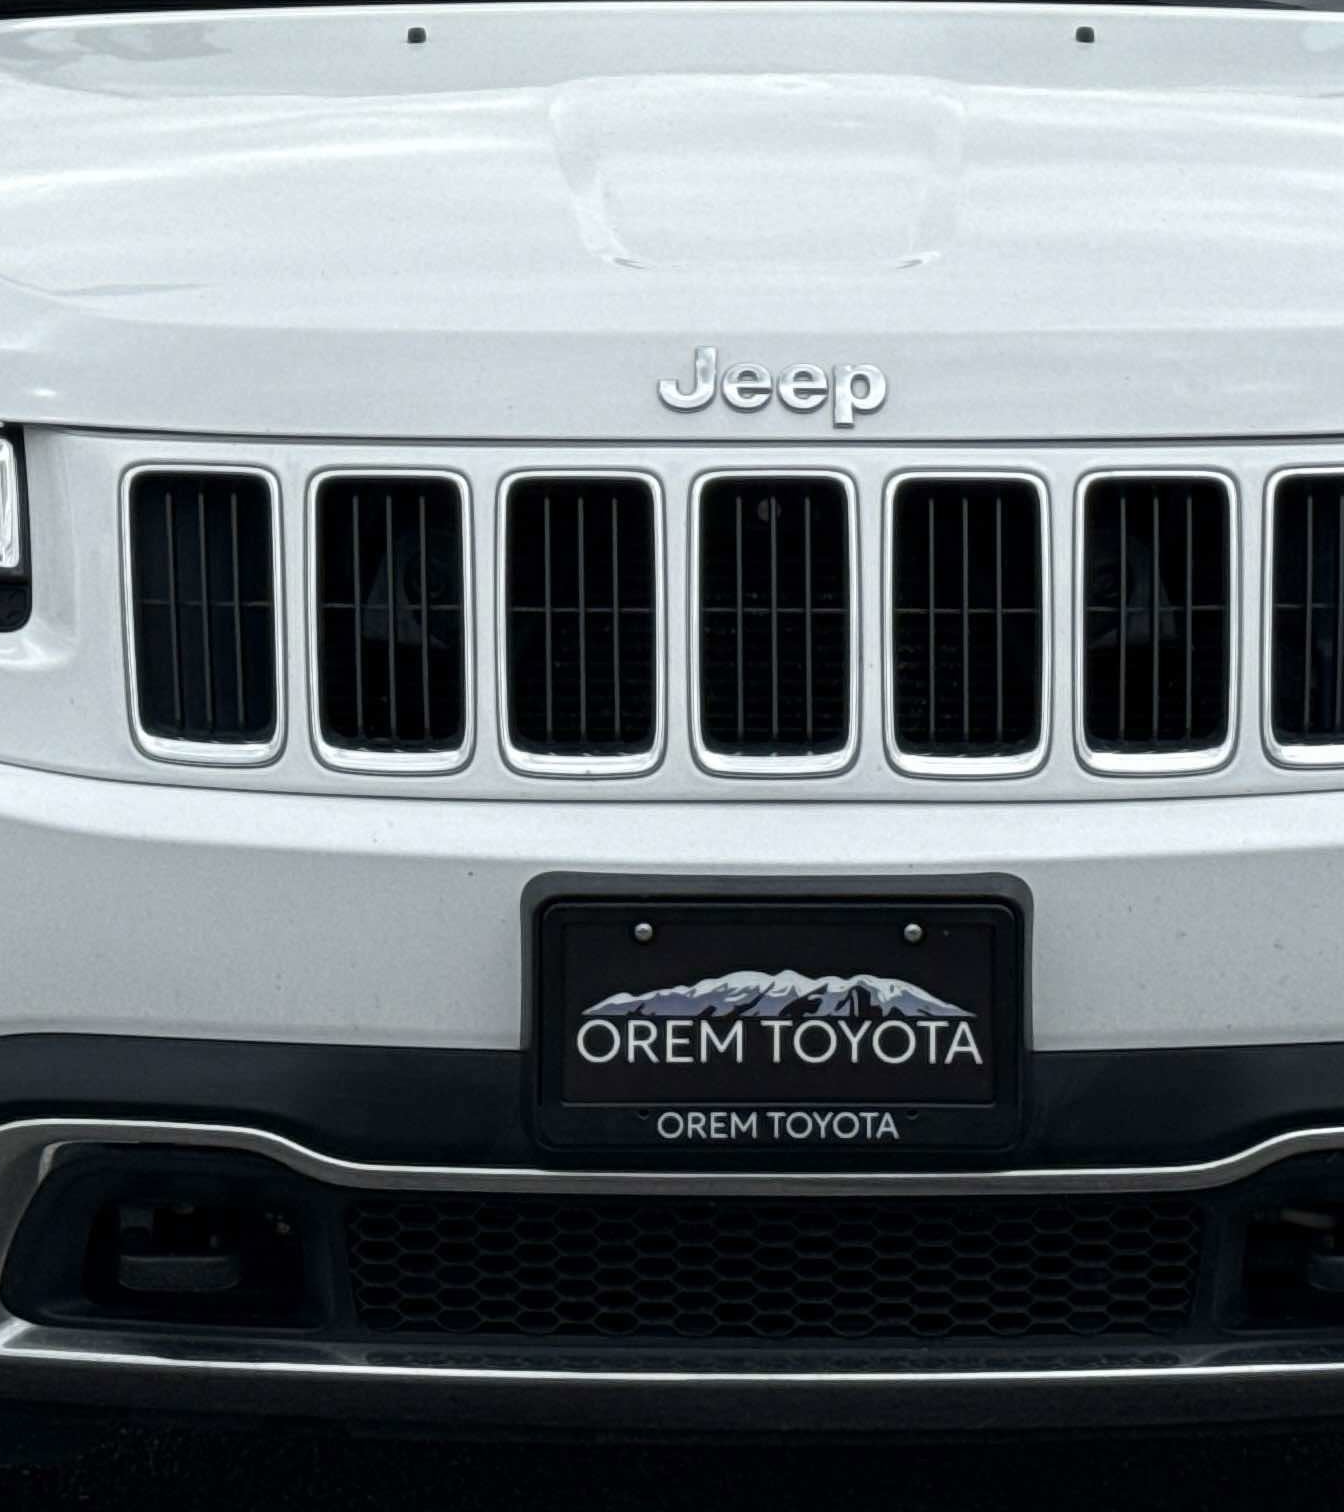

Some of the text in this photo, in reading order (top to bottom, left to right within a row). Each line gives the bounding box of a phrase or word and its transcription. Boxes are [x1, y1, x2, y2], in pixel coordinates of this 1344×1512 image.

[658, 345, 887, 429] Jeep
[577, 1020, 984, 1065] OREM TOYOTA
[657, 1111, 900, 1140] OREM TOYOTA
